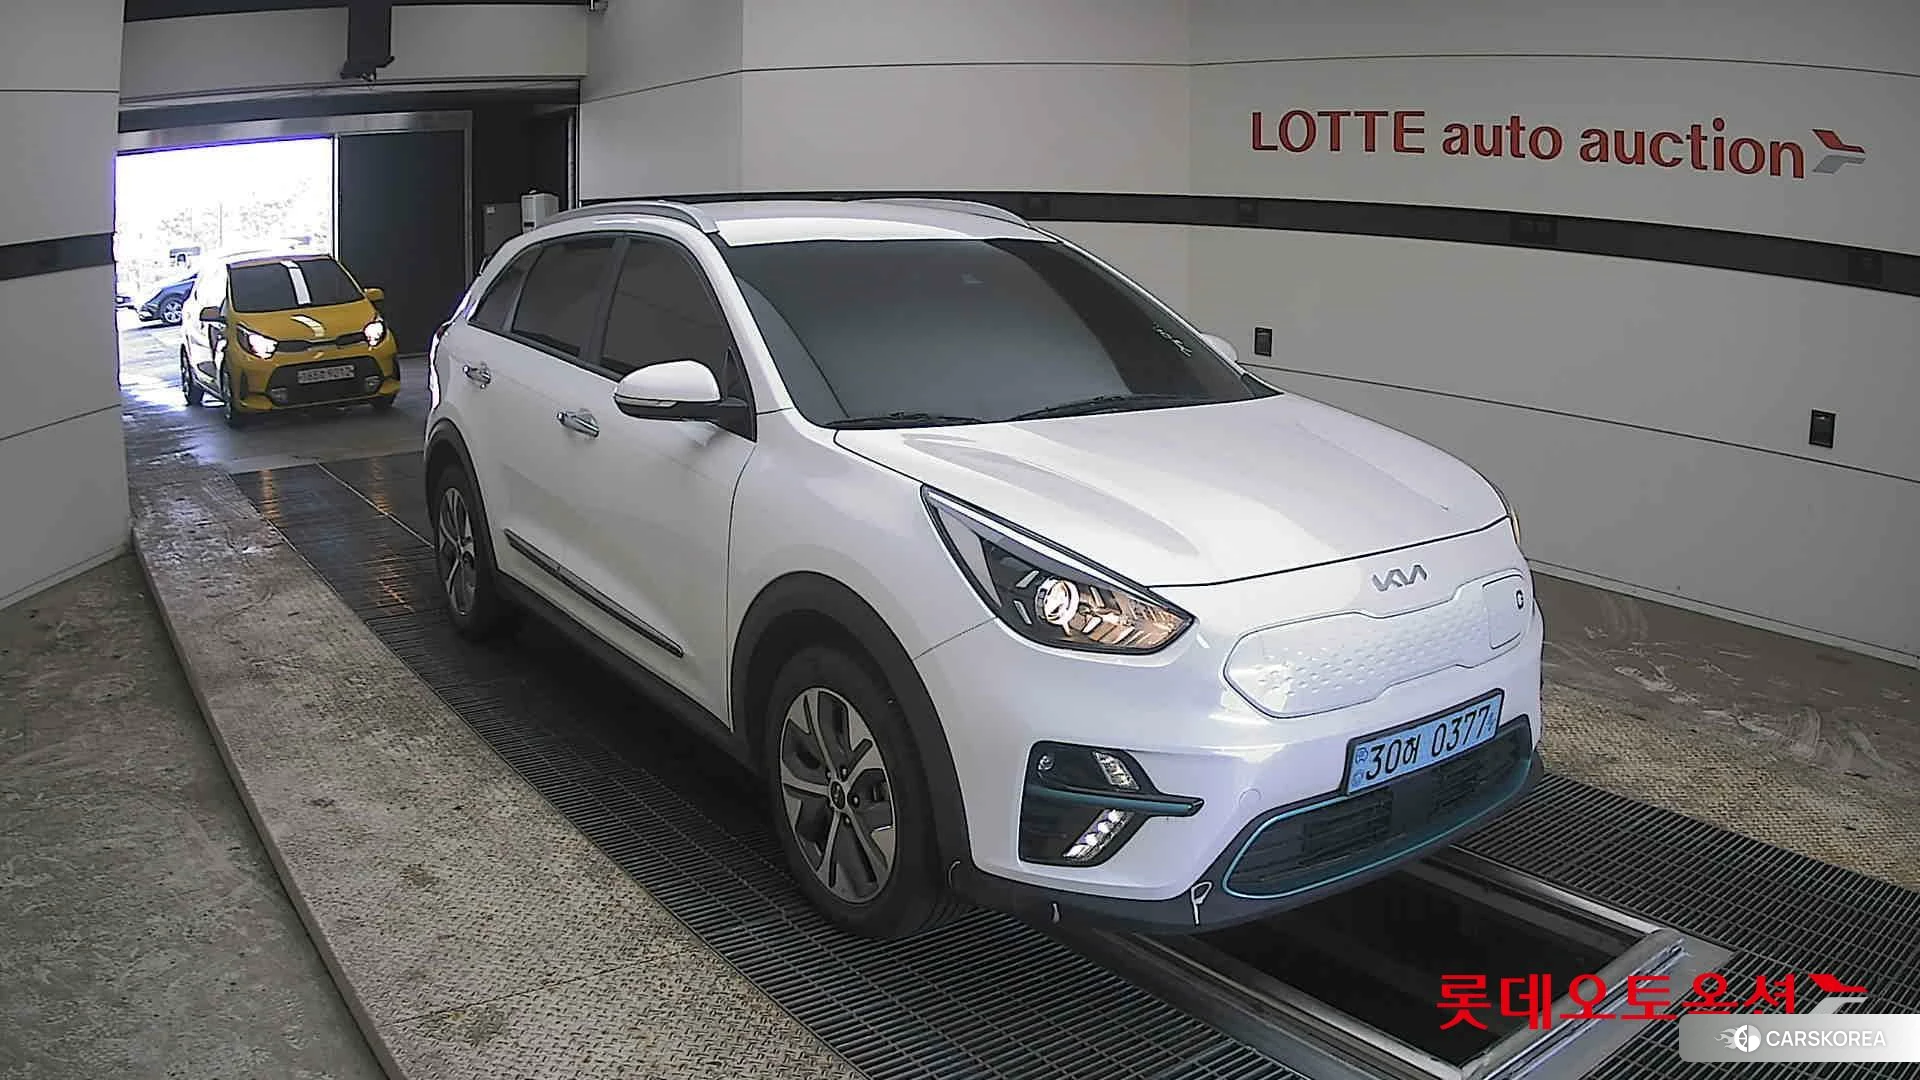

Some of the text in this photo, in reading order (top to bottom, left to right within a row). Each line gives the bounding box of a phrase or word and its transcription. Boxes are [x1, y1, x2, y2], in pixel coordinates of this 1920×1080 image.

[1252, 110, 1804, 179] LOTTE auto auction
[1431, 704, 1492, 758] 0377
